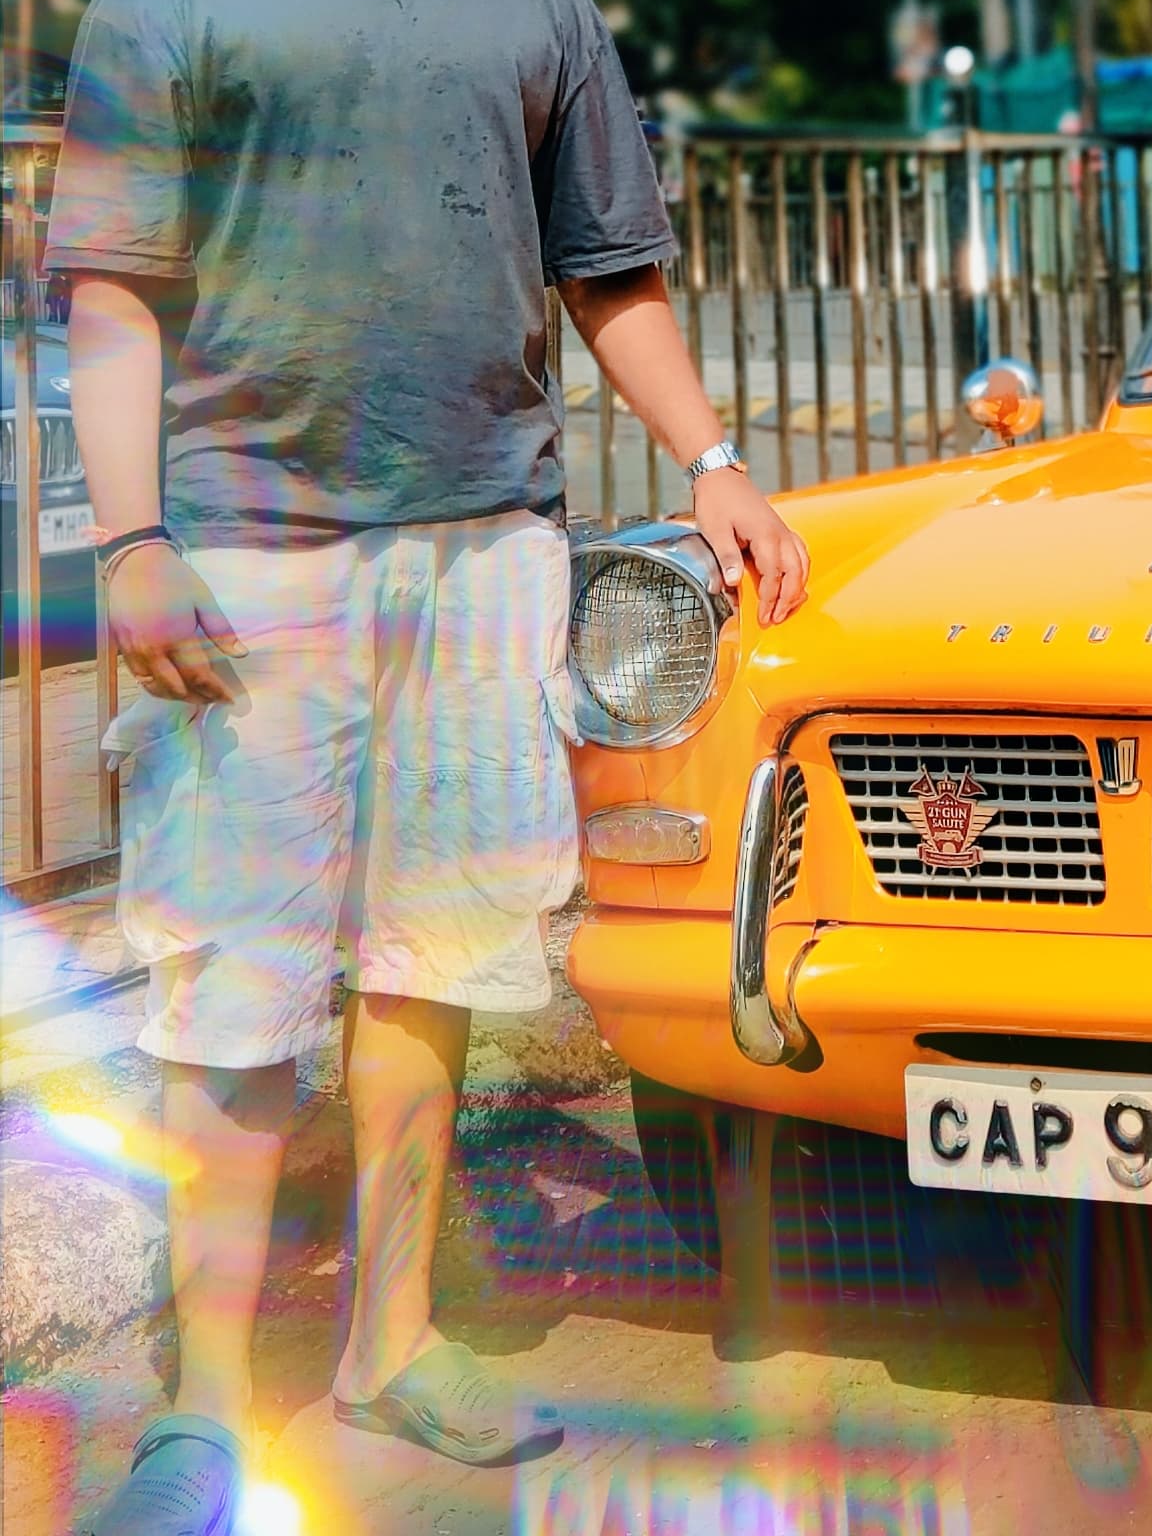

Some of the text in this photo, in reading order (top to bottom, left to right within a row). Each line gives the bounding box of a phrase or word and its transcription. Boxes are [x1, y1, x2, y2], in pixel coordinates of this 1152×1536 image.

[942, 807, 967, 819] GUN
[932, 818, 965, 830] SALUTE
[930, 1096, 1075, 1171] CAP
